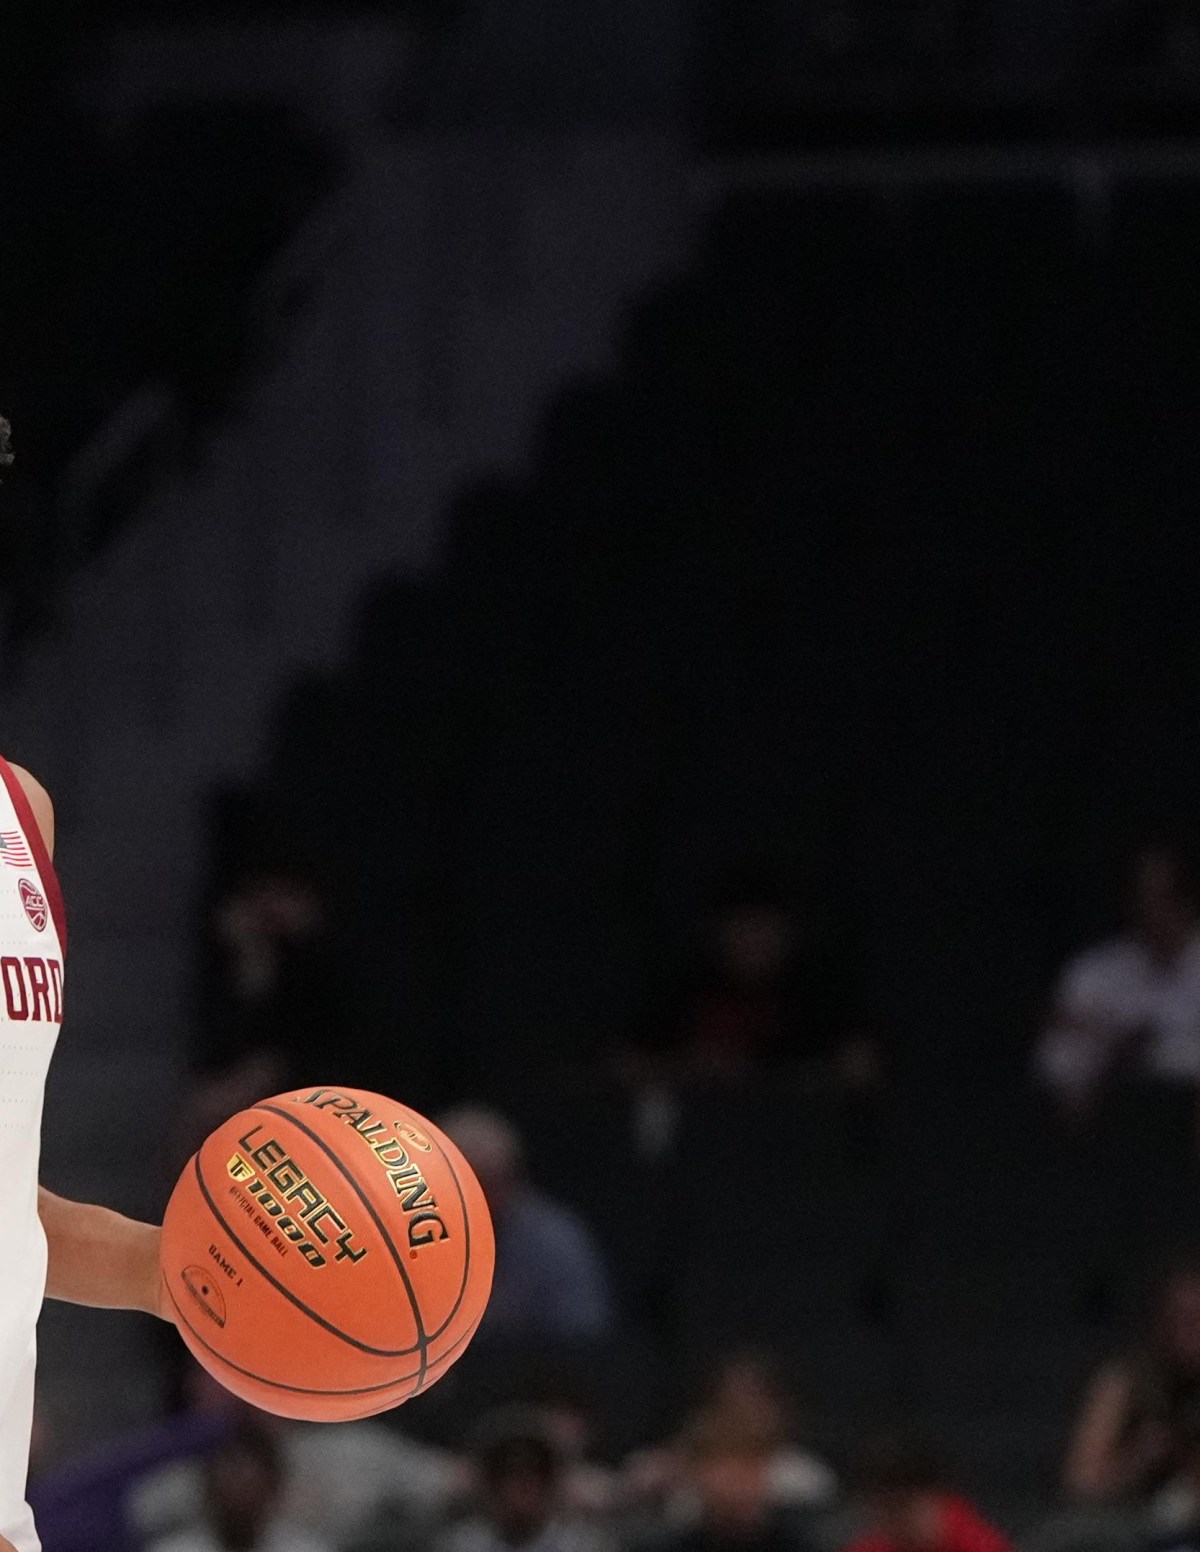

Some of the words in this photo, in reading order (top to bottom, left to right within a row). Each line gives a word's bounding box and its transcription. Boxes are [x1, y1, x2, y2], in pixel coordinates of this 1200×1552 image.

[229, 1154, 253, 1179] TF
[246, 1178, 327, 1269] 1000
[237, 1125, 368, 1266] LEGACY
[293, 1089, 449, 1248] SPALDING
[270, 1236, 288, 1258] BALL
